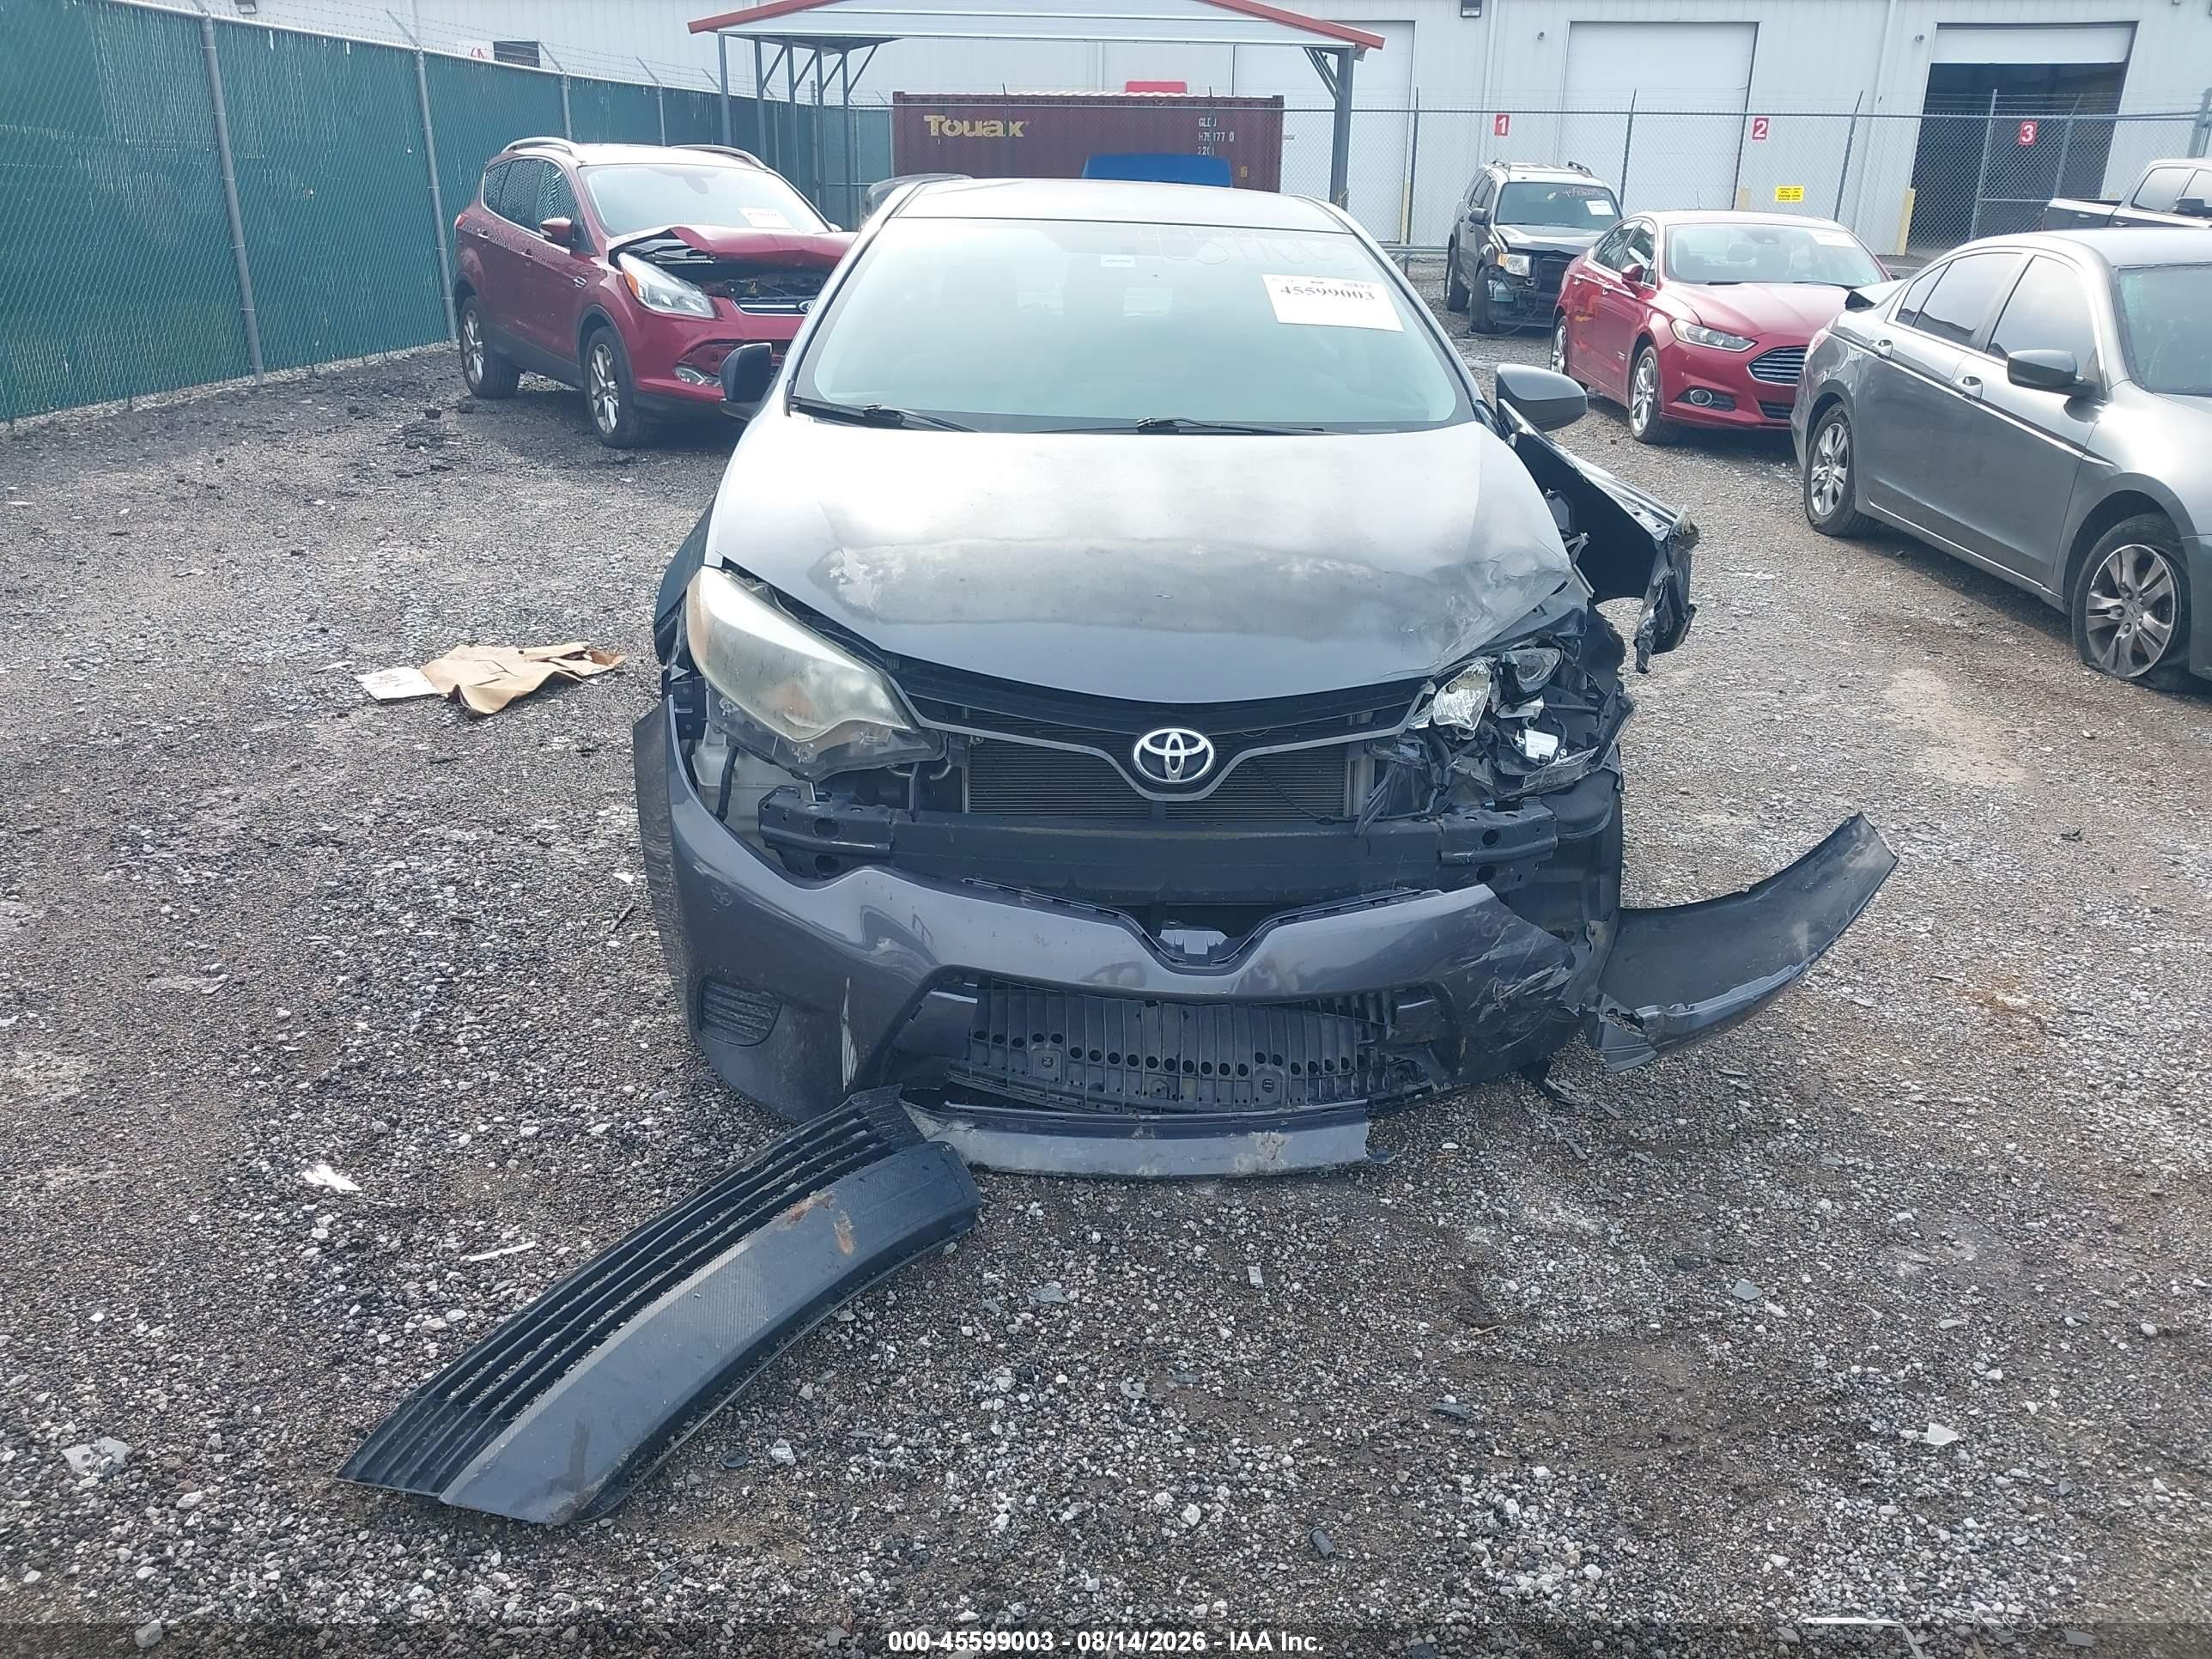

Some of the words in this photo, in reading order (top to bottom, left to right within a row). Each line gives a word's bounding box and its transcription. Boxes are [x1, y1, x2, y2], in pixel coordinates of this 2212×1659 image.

[923, 115, 1024, 137] Touax
[1498, 116, 1507, 134] 1
[1754, 120, 1767, 138] 2
[2021, 125, 2034, 143] 3
[1279, 285, 1376, 301] 45599003
